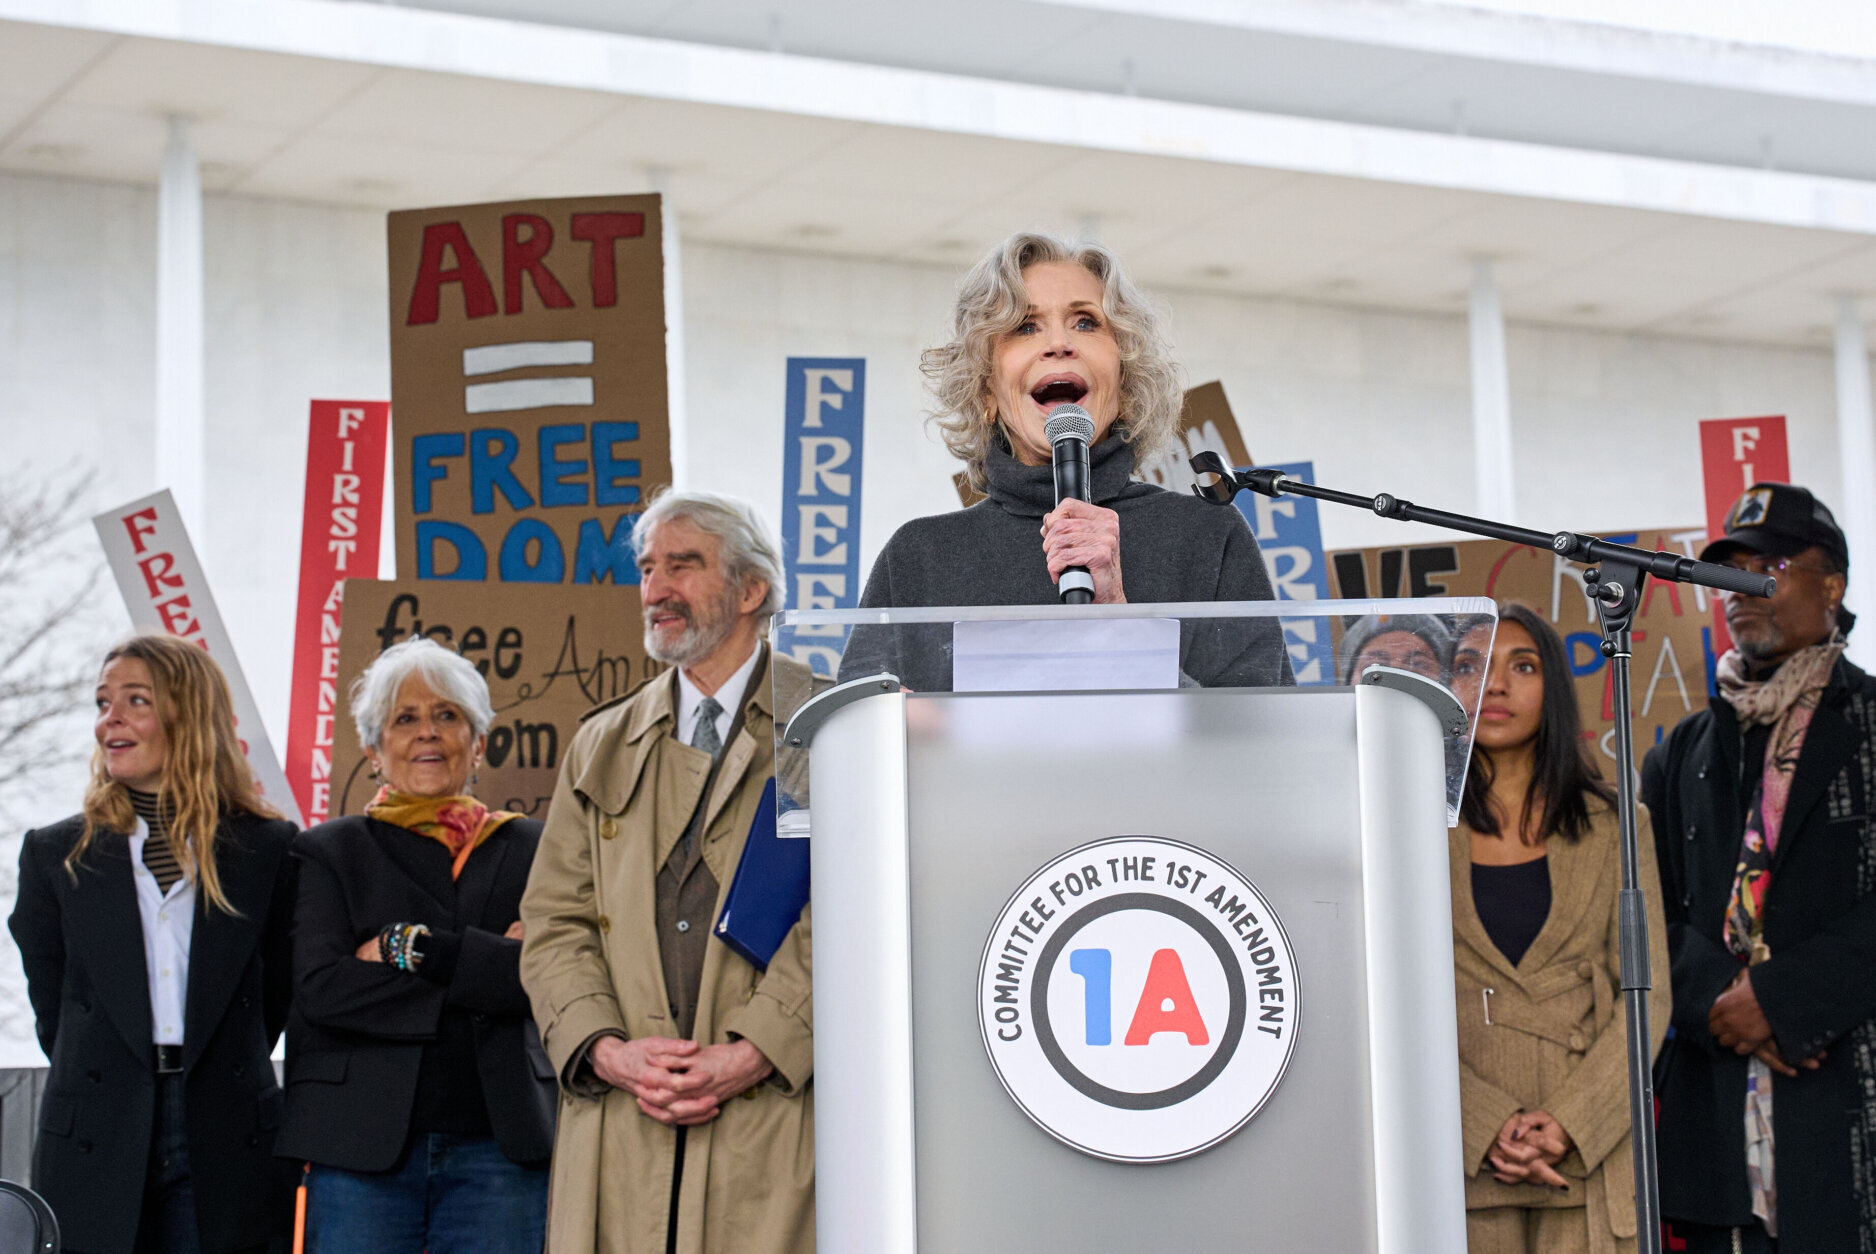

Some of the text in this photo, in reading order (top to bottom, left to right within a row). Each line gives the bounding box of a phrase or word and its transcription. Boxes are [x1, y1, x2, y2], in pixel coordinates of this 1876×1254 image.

[406, 212, 645, 326] ART
[328, 408, 365, 572] FIRST
[411, 421, 642, 514] FREE
[415, 513, 645, 587] DOM
[993, 856, 1285, 1043] COMMITTEE FOR THE 1ST AMENDMENT
[1069, 948, 1210, 1046] 1A
